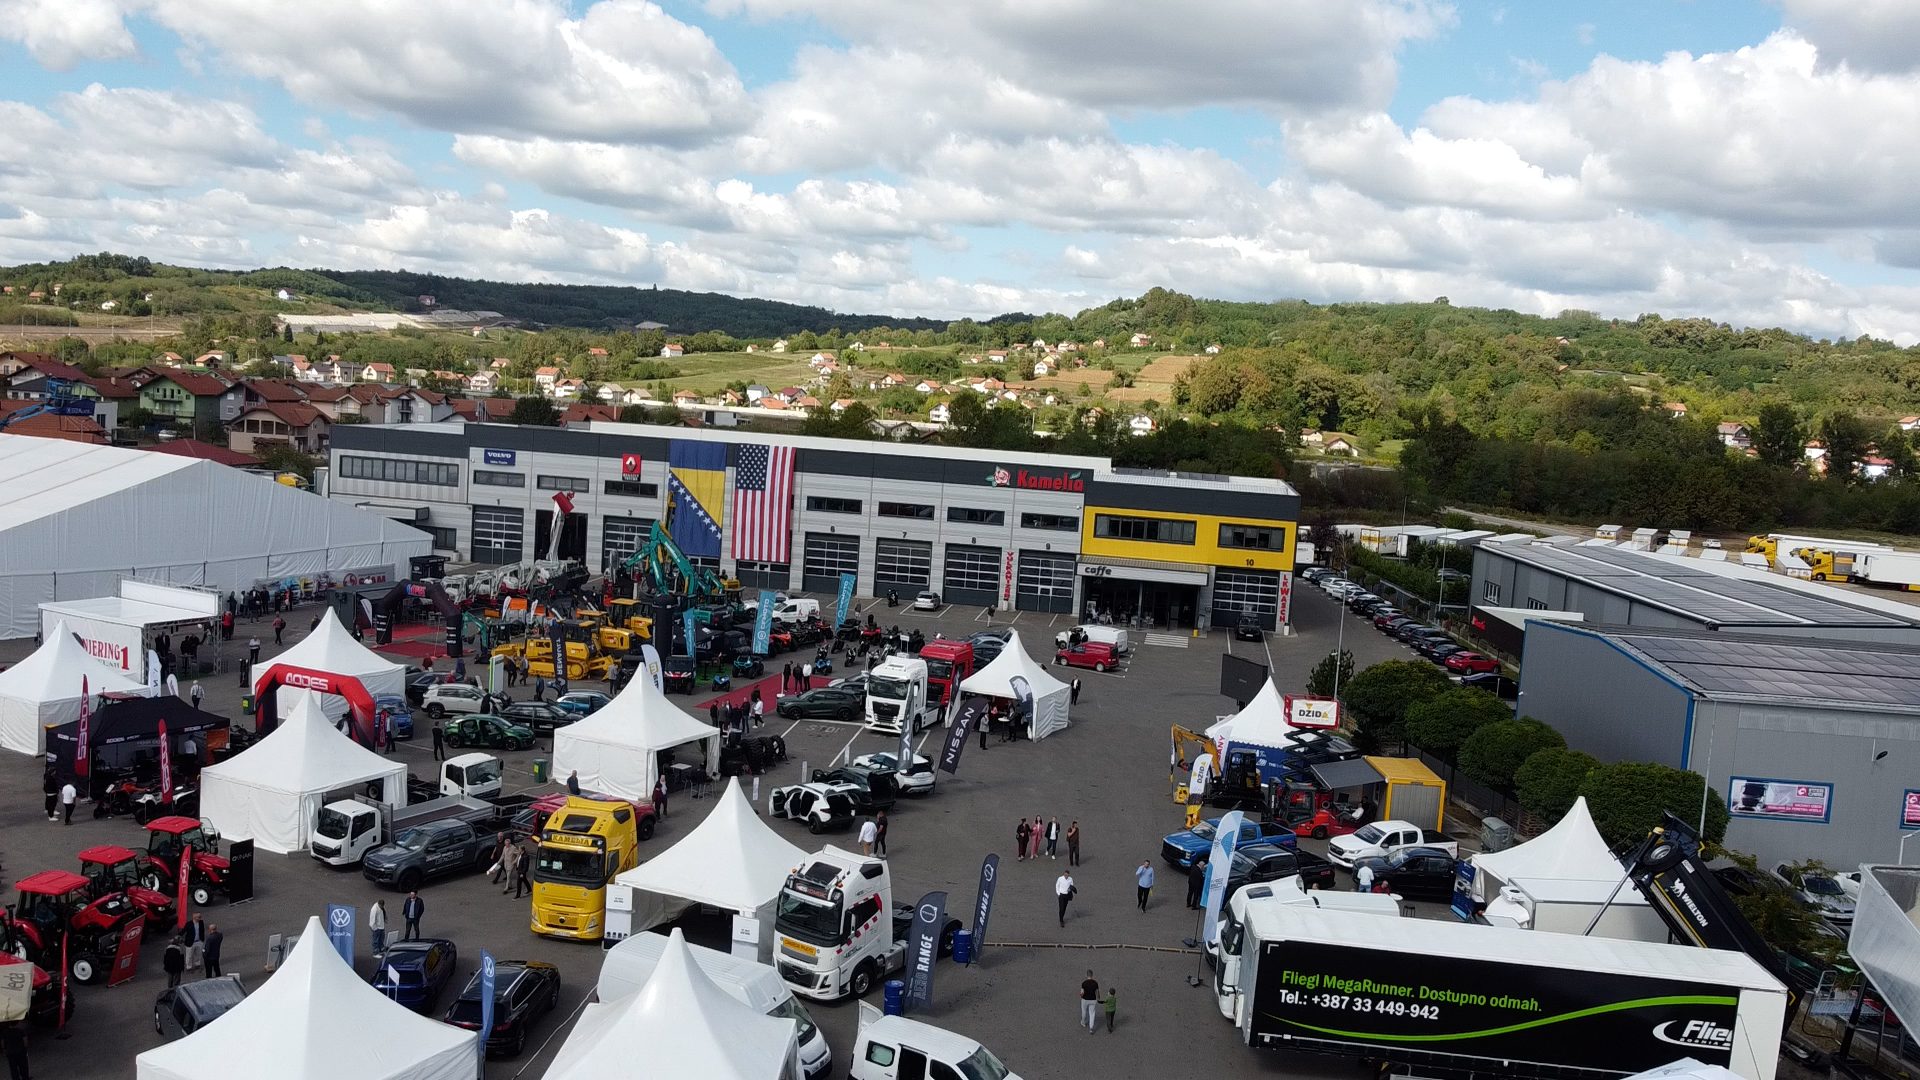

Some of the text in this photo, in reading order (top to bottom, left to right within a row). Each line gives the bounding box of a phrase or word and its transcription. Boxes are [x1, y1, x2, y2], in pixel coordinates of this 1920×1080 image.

[487, 451, 512, 459] VOLVO
[1017, 470, 1084, 492] Kamelia
[1084, 565, 1112, 577] caffe
[1245, 558, 1254, 567] 10
[81, 637, 120, 661] NJERING
[120, 646, 130, 671] 1
[285, 672, 329, 691] AODES
[945, 706, 976, 764] NISSAN
[979, 890, 990, 926] RANGE
[1681, 891, 1709, 929] WIELTON
[916, 933, 934, 972] RANGE
[1279, 989, 1440, 1020] Tel.: +387 33 449-942
[1282, 970, 1542, 1012] Fliegl MegaRunner. Dostupno odmah.
